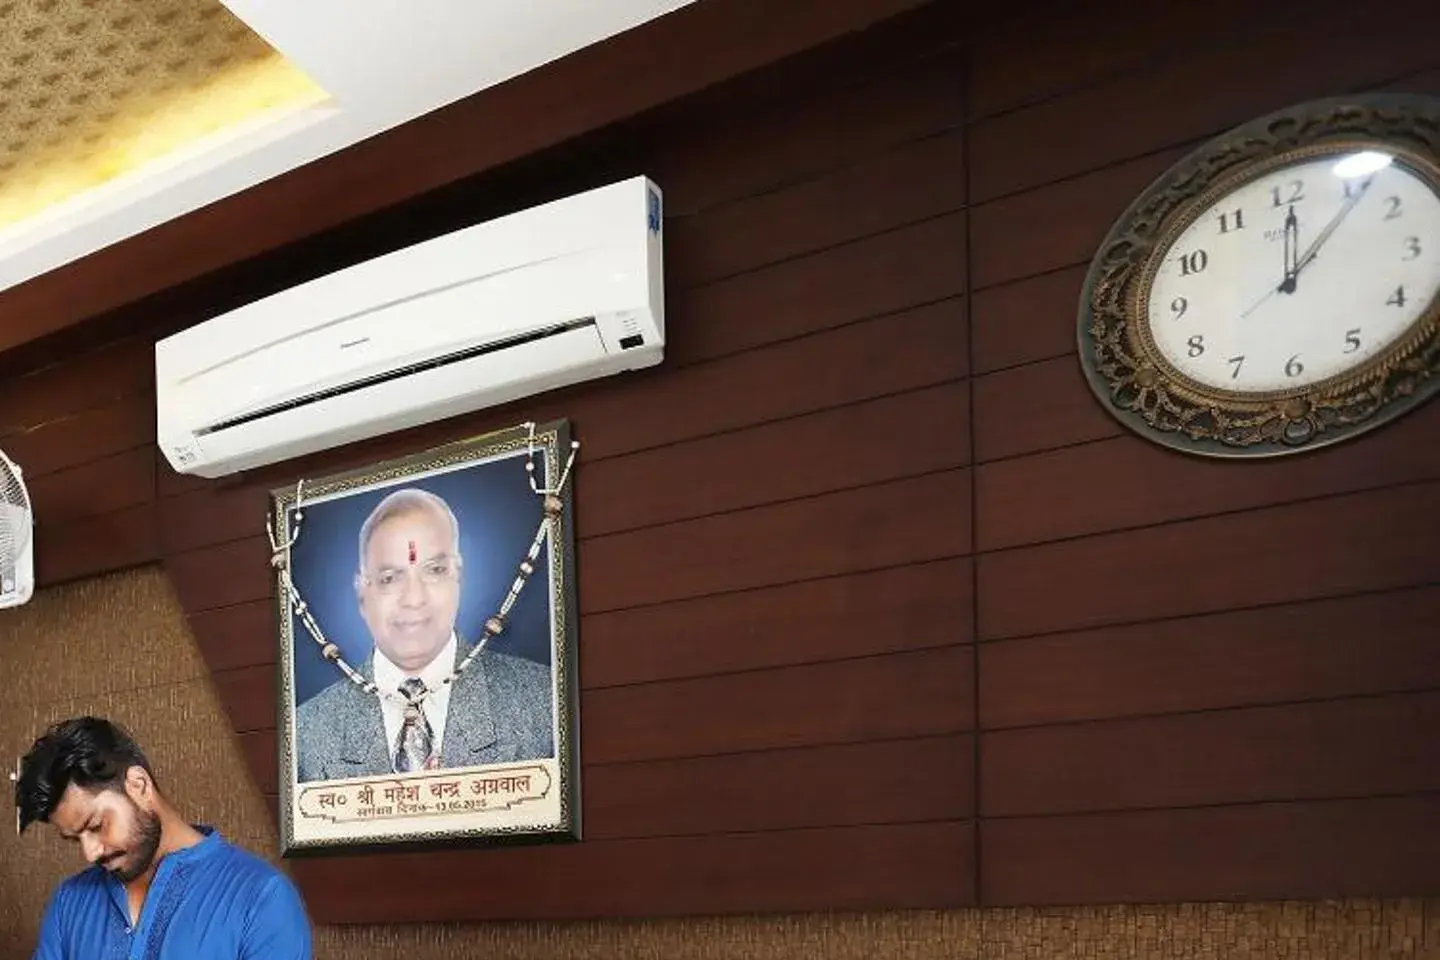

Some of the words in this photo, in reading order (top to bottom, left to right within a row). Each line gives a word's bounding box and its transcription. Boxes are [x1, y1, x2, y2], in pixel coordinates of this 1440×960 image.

[1269, 179, 1306, 208] 12
[1216, 208, 1246, 234] 11
[1382, 195, 1402, 221] 2
[1401, 236, 1421, 262] 3
[1177, 248, 1208, 277] 10
[1170, 296, 1188, 320] 9
[1385, 285, 1407, 308] 4
[1187, 334, 1205, 358] 8
[1342, 328, 1361, 354] 5
[1228, 354, 1248, 379] 7
[1284, 354, 1305, 378] 6
[356, 785, 375, 807] श्री
[383, 780, 421, 803] महेश
[429, 780, 462, 800] चन्द्र
[470, 774, 531, 796] अग्रवाल
